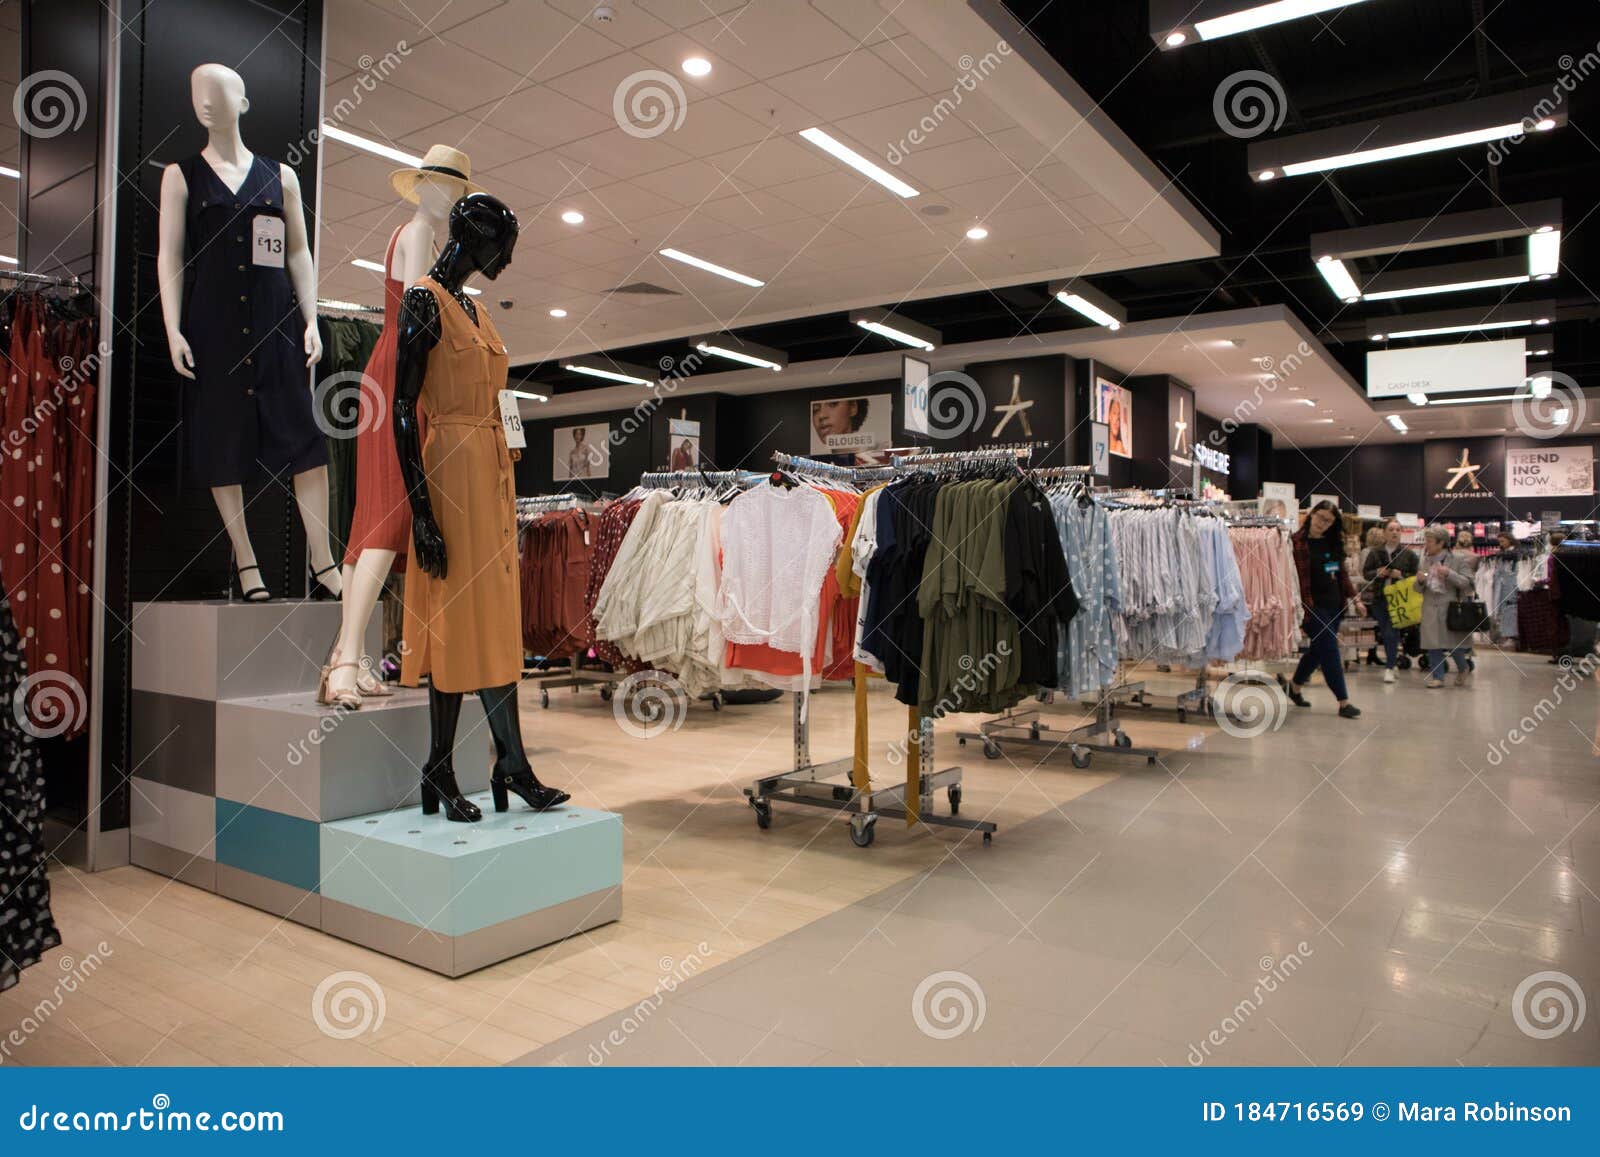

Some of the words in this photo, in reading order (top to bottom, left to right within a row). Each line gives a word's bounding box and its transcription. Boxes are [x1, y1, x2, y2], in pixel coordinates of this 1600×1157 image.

[257, 236, 282, 254] £13
[828, 435, 873, 447] BLOUSES
[1511, 453, 1560, 465] TREND
[1512, 465, 1541, 475] ING
[1513, 475, 1550, 487] NOW
[1434, 491, 1493, 499] ATMOSPHERE
